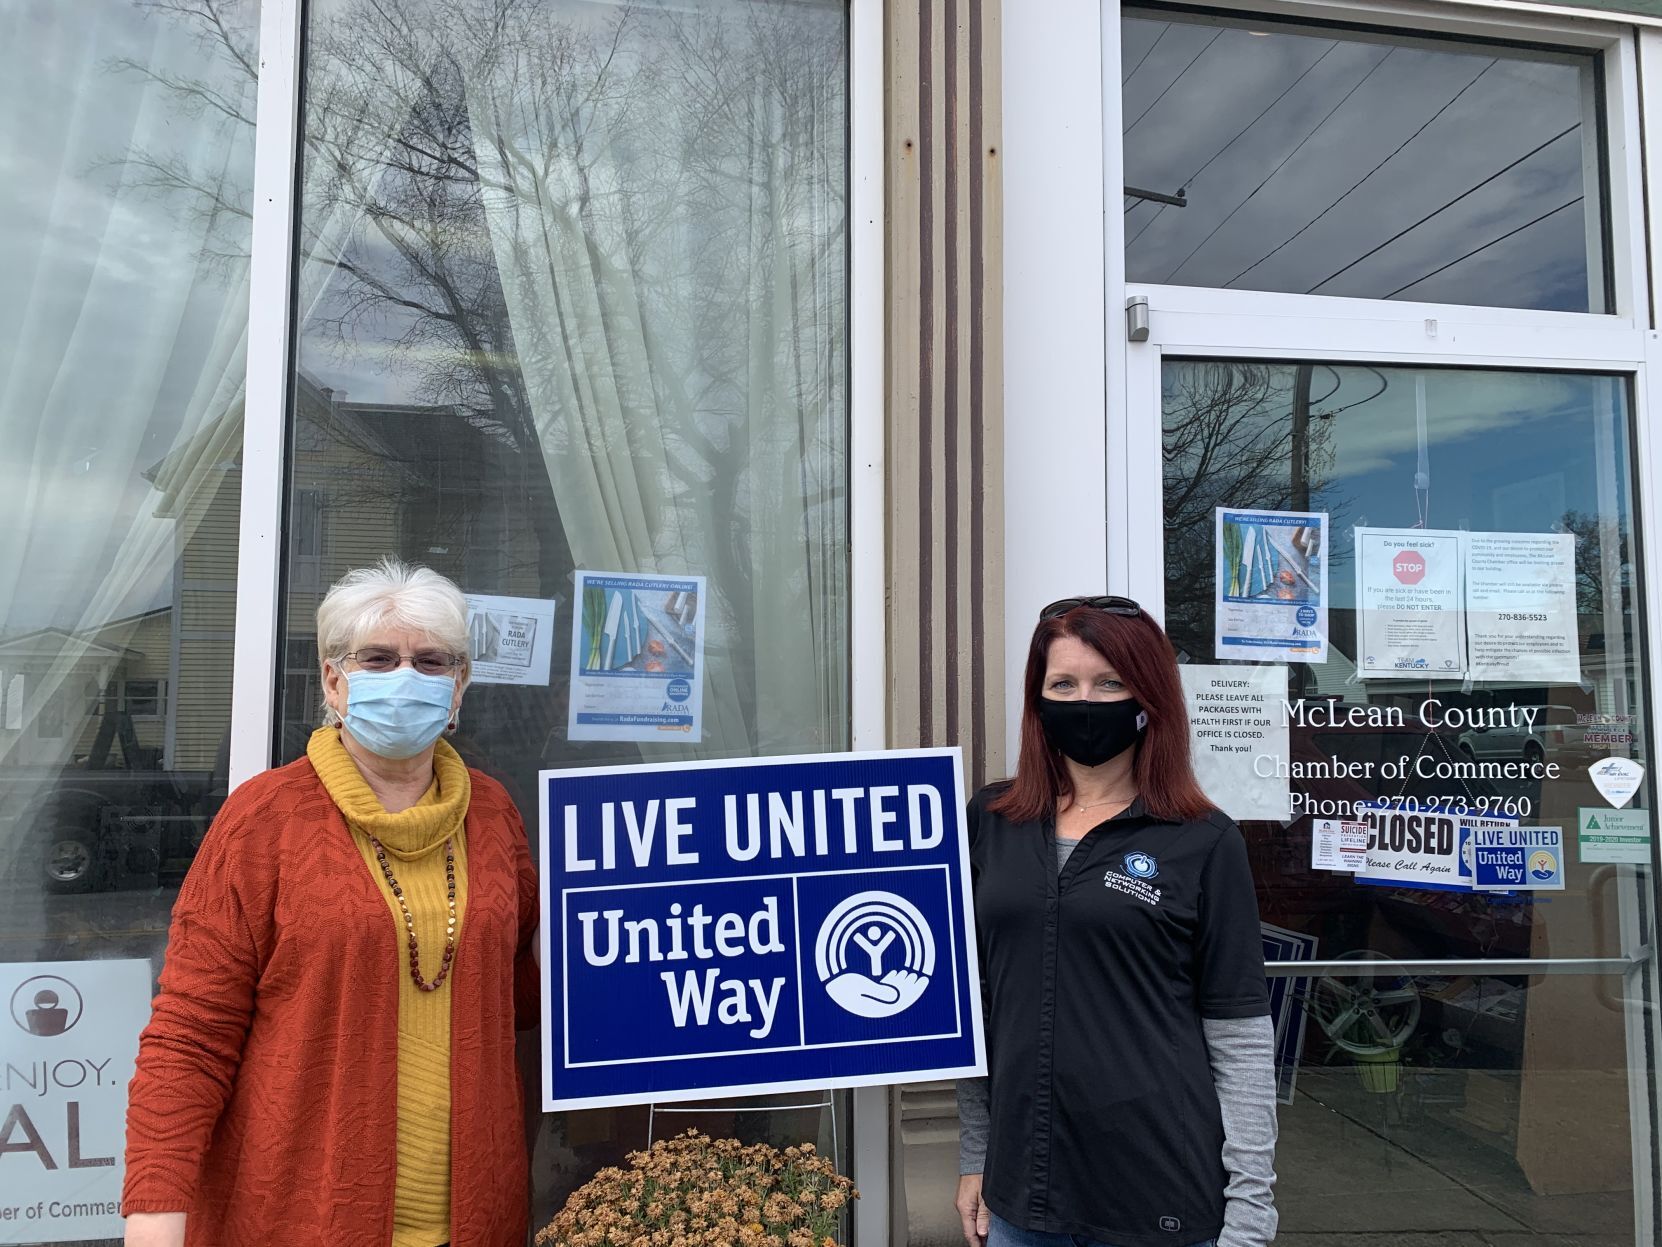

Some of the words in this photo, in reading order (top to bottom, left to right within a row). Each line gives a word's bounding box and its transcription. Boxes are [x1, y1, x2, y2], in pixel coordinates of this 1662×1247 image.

[1396, 563, 1423, 573] STOP
[1498, 613, 1547, 621] 270-836-5523
[508, 630, 526, 639] RADA
[502, 638, 530, 648] CUTLERY
[1211, 680, 1250, 688] DELIVERY:
[1196, 693, 1224, 701] PLEASE
[1226, 694, 1249, 702] LEAVE
[1251, 694, 1264, 702] ALL
[1199, 706, 1239, 714] PACKAGES
[1241, 706, 1262, 714] WITH
[1280, 698, 1405, 728] McLean
[1419, 699, 1539, 735] County
[1191, 718, 1220, 726] HEALTH
[1253, 719, 1271, 727] OUR
[1197, 730, 1223, 738] OFFICE
[1233, 731, 1265, 739] CLOSED.
[1584, 733, 1633, 743] MEMBER
[1210, 744, 1233, 752] Thank
[1235, 745, 1252, 753] you!
[1253, 755, 1375, 780] Chamber
[1381, 755, 1409, 779] of
[1416, 755, 1561, 780] Commerce
[1288, 792, 1373, 817] Phone:
[1377, 795, 1532, 818] 270-273-9760
[1460, 818, 1478, 827] WILL
[1604, 814, 1624, 823] Junior
[564, 797, 700, 872] LIVE
[724, 783, 944, 862] UNITED
[1341, 825, 1367, 835] SUICIDE
[1362, 811, 1454, 856] CLOSED
[1604, 823, 1644, 831] Achievement
[1474, 830, 1504, 846] LIVE
[1509, 831, 1559, 846] UNITED
[1477, 851, 1523, 865] United
[1394, 859, 1417, 871] Call
[1420, 862, 1452, 877] Again
[1495, 866, 1523, 882] Way
[1103, 875, 1160, 902] NETWORKING
[1106, 870, 1153, 892] COMPUTER
[1154, 889, 1162, 897] &
[1104, 881, 1157, 906] SOLUTIONS
[577, 896, 785, 967] United
[660, 967, 786, 1040] Way
[0, 1056, 116, 1097] NJOY.
[26, 1201, 43, 1220] of
